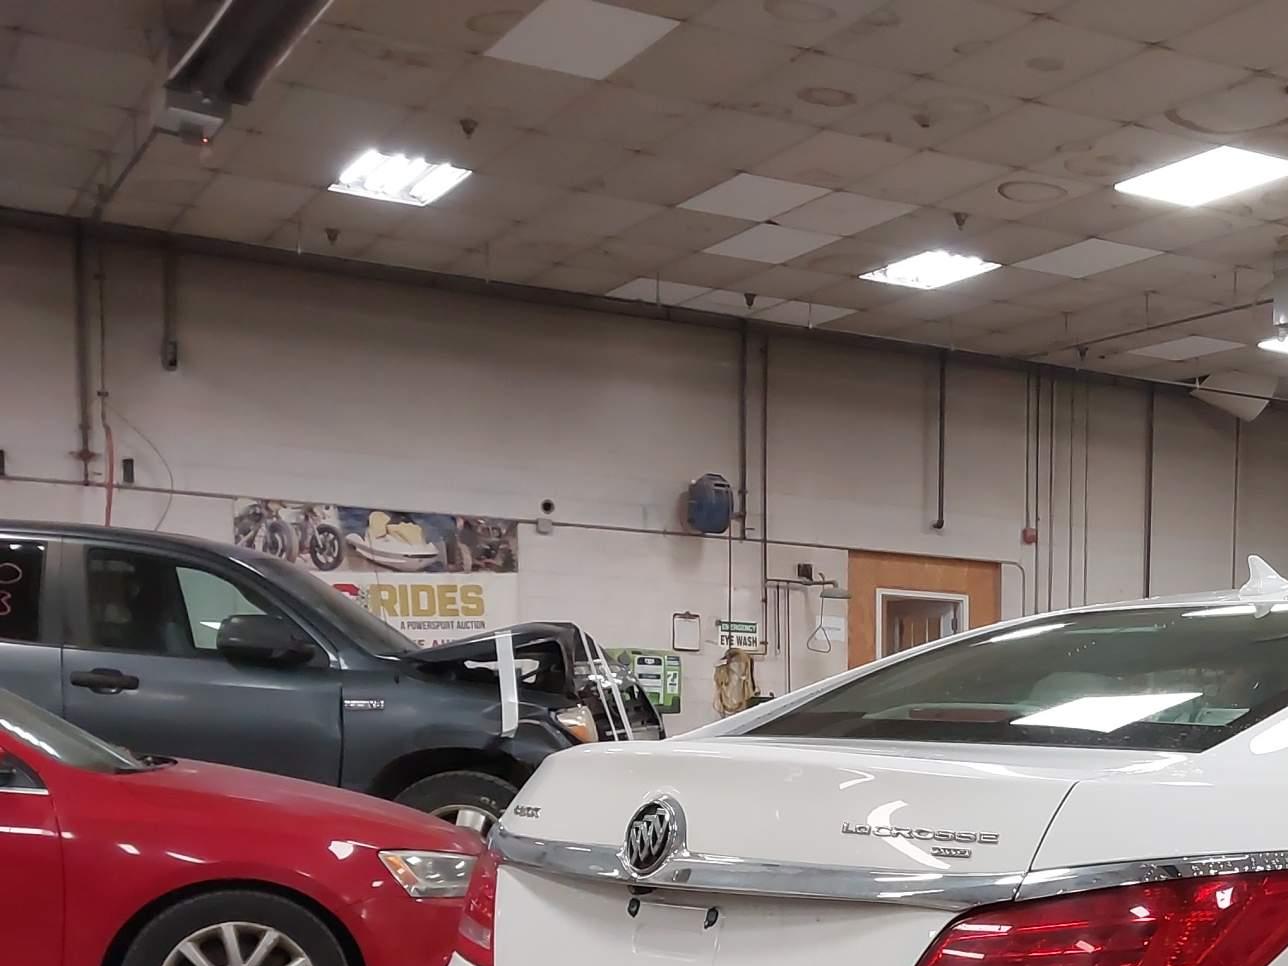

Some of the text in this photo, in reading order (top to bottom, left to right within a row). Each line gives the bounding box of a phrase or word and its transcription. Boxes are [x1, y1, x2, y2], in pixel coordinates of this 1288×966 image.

[369, 584, 485, 617] RIDES
[407, 621, 454, 630] POWERSPORT
[457, 621, 486, 630] AUCTION
[720, 634, 758, 648] EYE WASH
